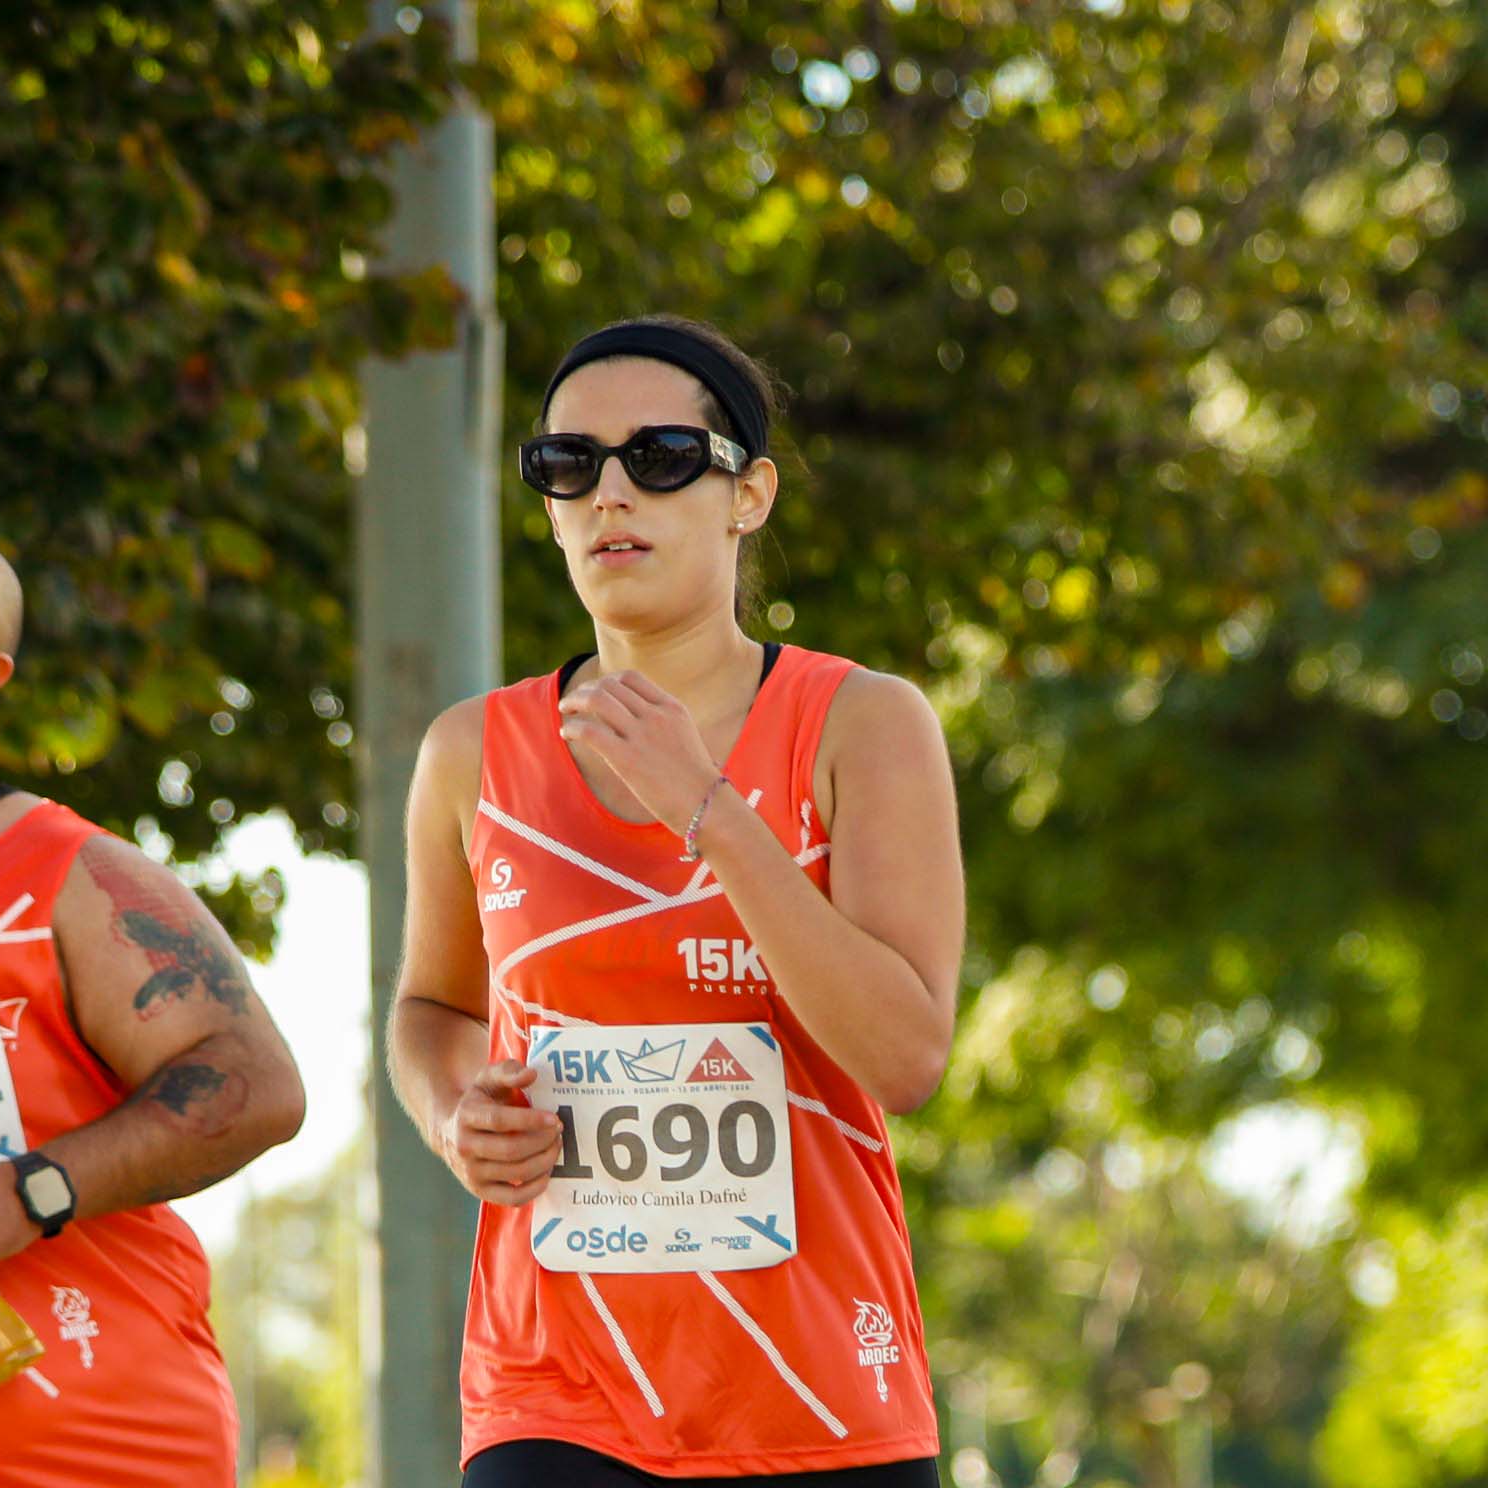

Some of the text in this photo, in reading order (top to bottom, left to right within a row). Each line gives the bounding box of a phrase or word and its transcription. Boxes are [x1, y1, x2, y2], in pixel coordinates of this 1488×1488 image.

[677, 937, 769, 981] 15K
[689, 983, 768, 995] PUERTO
[547, 1049, 612, 1084] 15K
[700, 1058, 737, 1077] 15K
[550, 1100, 776, 1182] 1690
[572, 1187, 747, 1206] Ludovico Camila Dafné
[566, 1224, 648, 1258] osde
[857, 1346, 900, 1367] ARDEC
